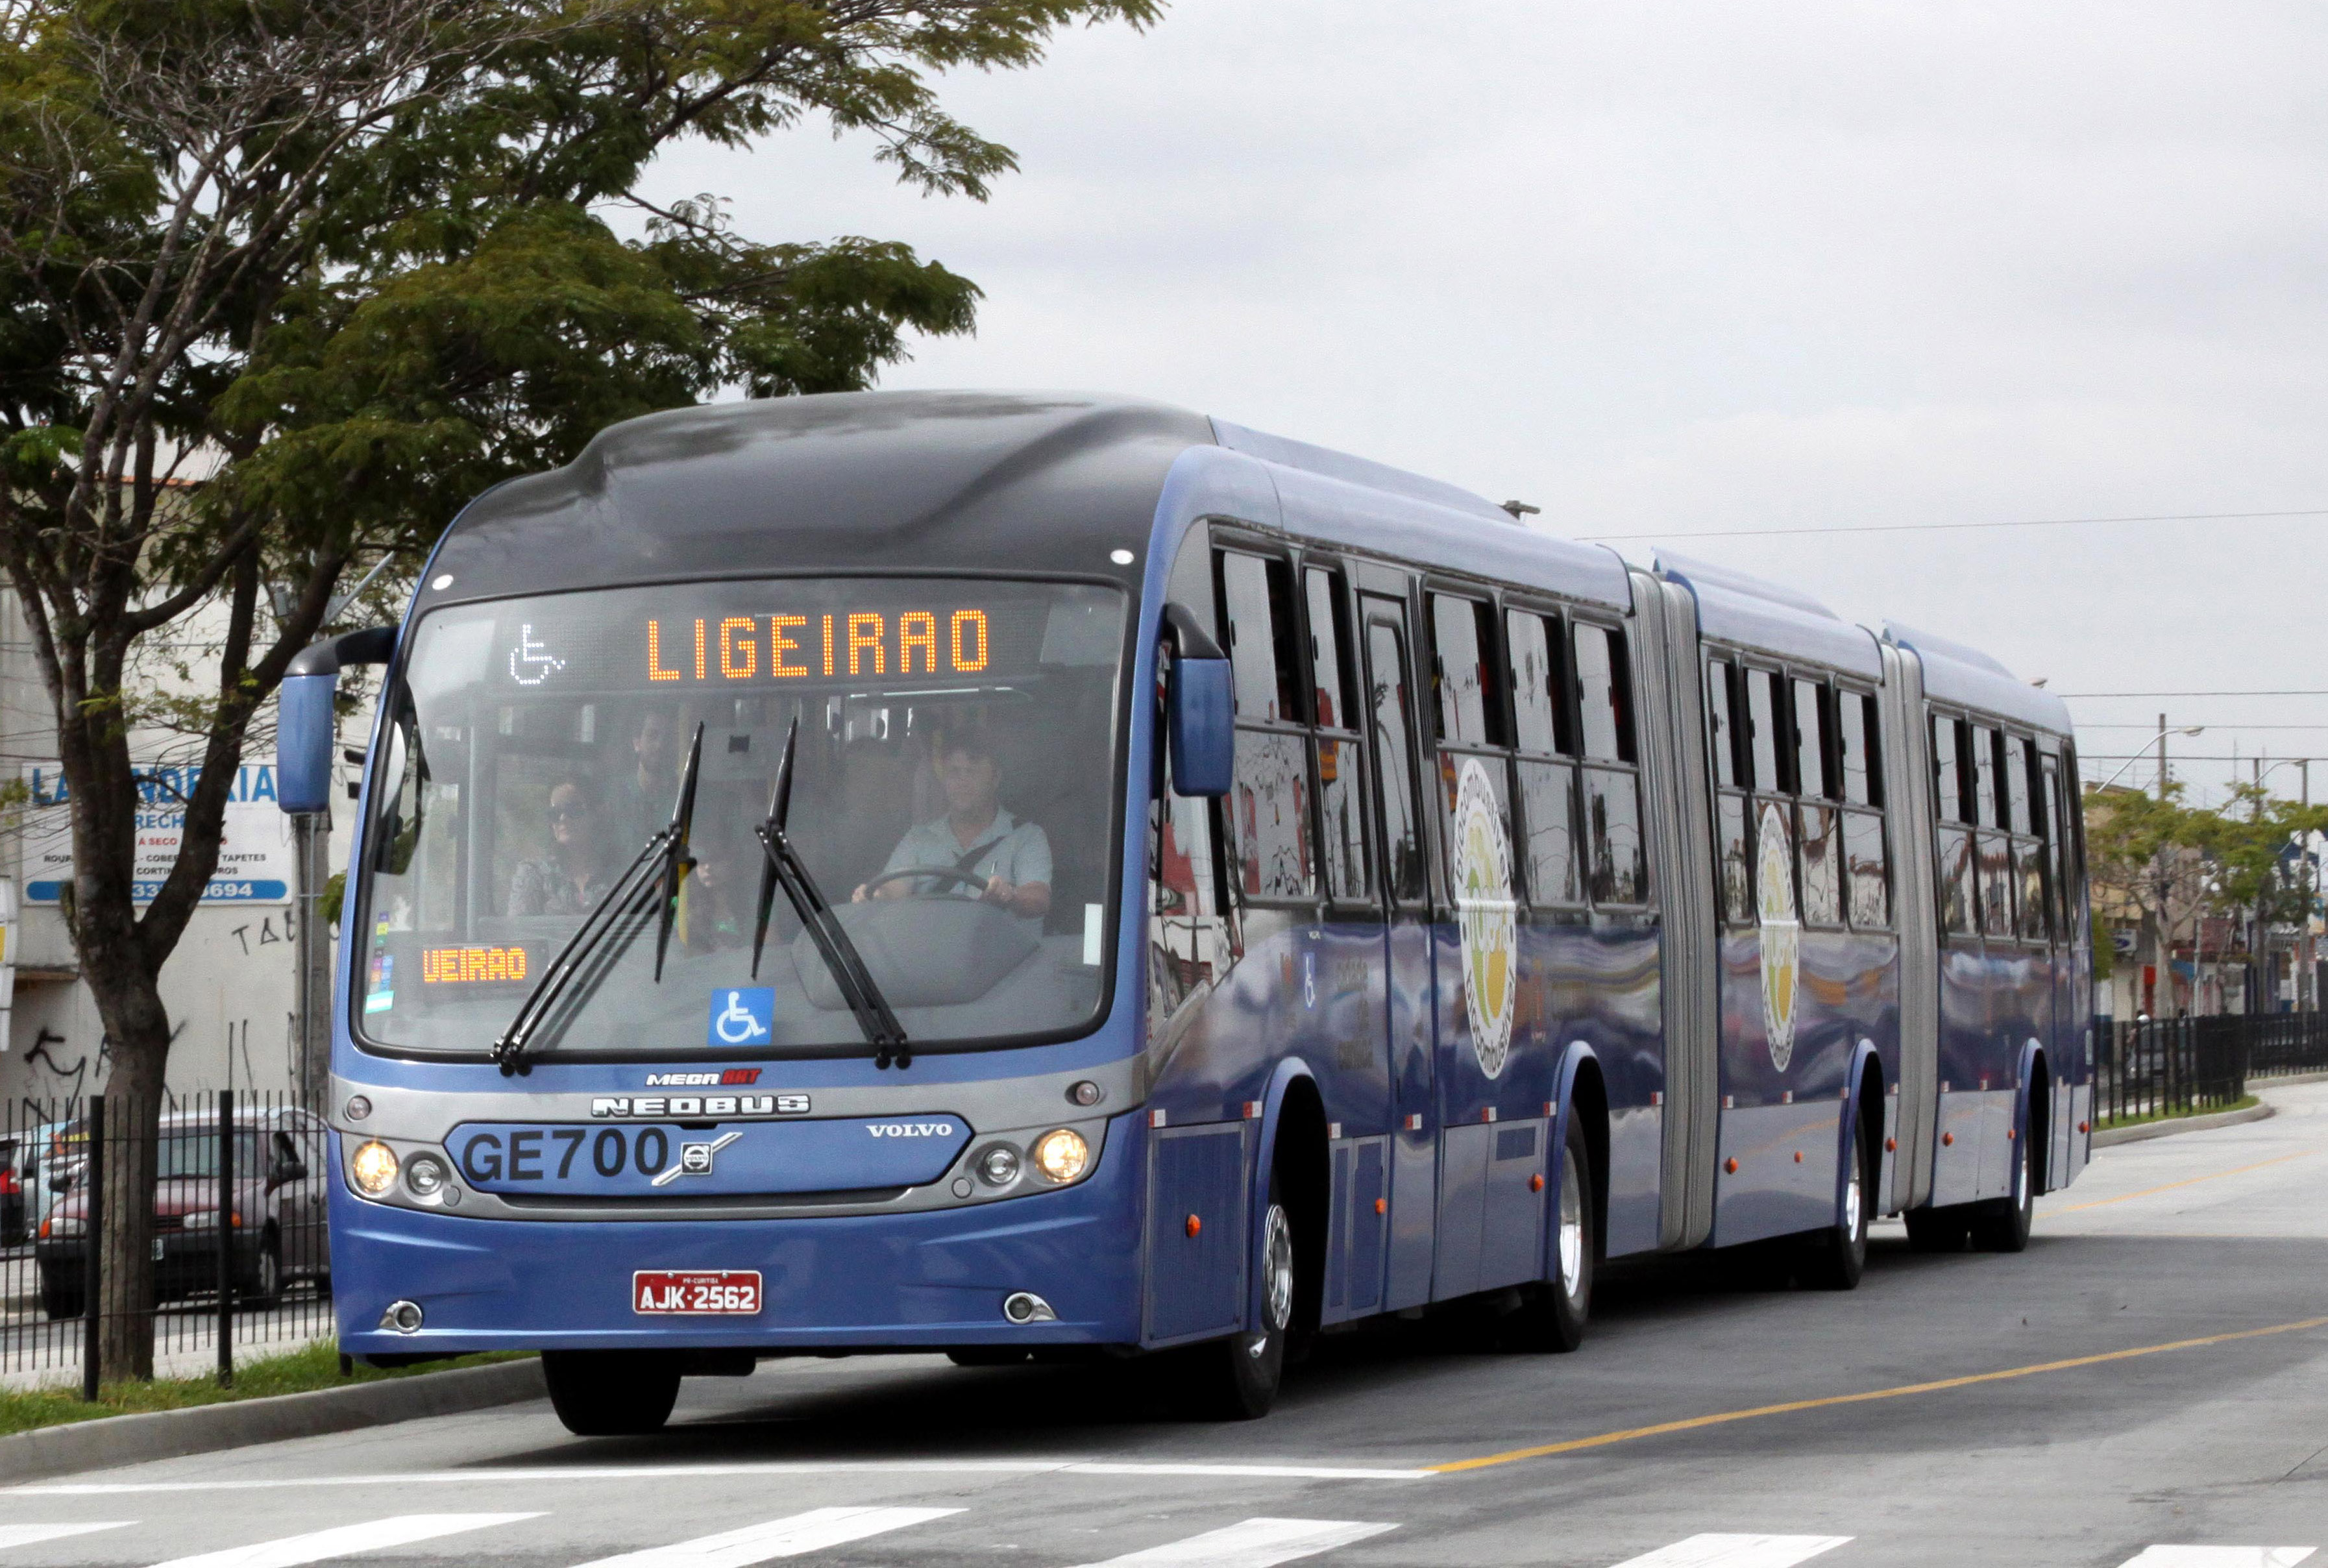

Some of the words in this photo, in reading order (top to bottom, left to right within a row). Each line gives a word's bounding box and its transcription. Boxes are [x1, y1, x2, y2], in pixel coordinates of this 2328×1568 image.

[648, 609, 988, 681] LIGEIRAO
[221, 853, 267, 862] TAPETES
[646, 1073, 720, 1085] MEGA
[591, 1095, 811, 1116] NEOBUS
[865, 1123, 953, 1137] VOLVO
[462, 1127, 668, 1182] GE700
